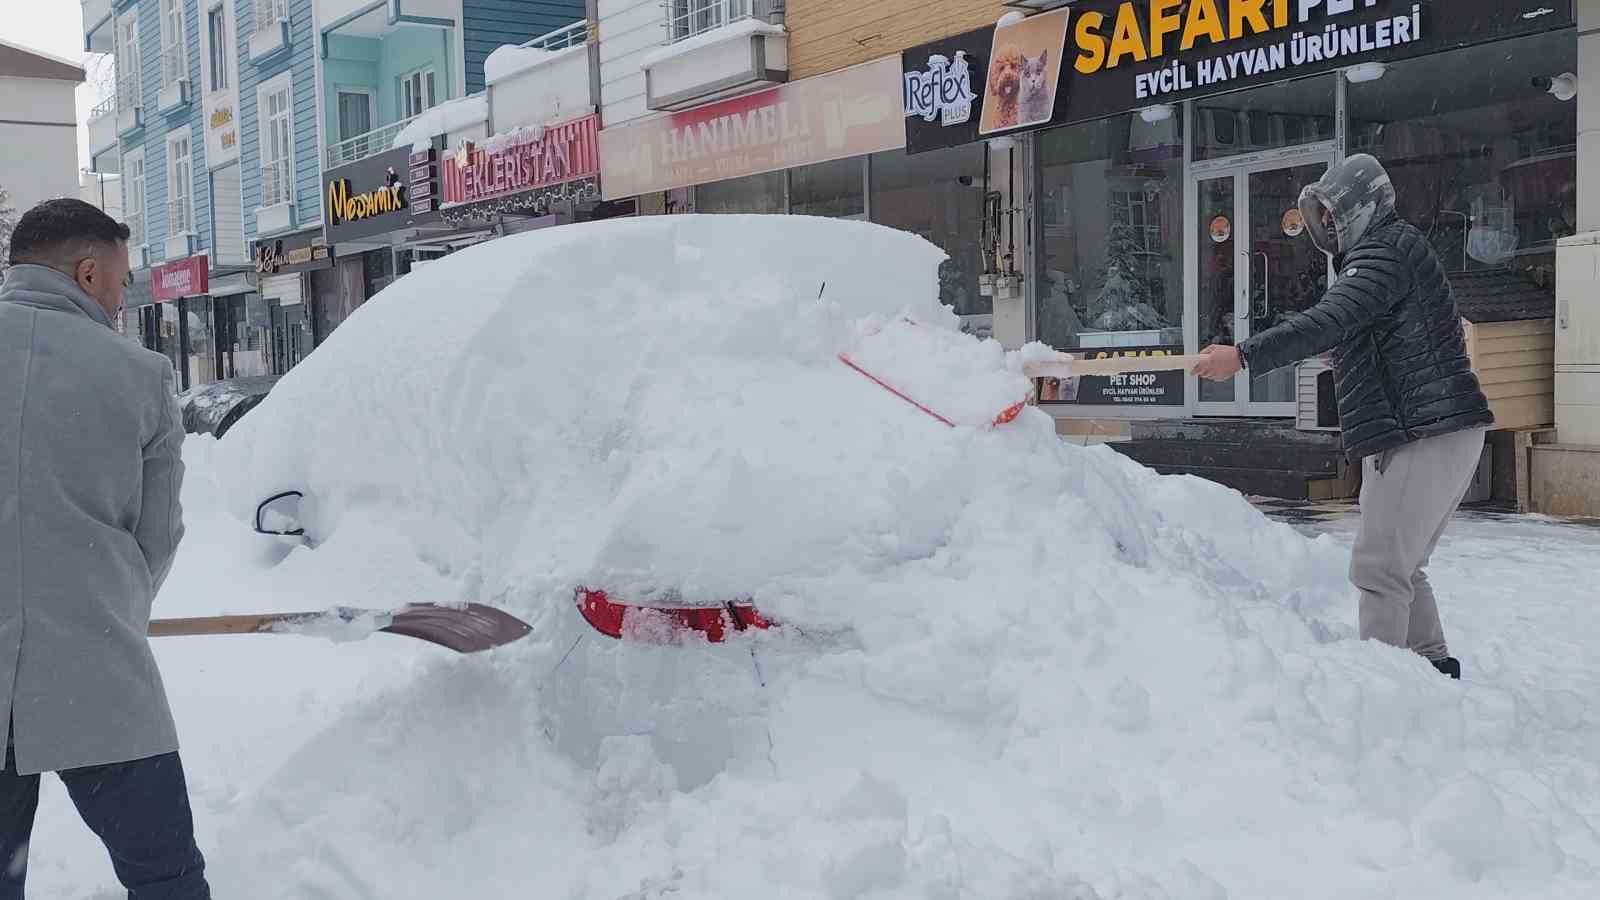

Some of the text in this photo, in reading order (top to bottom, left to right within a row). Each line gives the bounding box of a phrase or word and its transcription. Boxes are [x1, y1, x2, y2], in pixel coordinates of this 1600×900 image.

[1135, 59, 1193, 99] EVCİL
[1197, 42, 1285, 86] HAYVAN
[1291, 4, 1420, 66] ÜRÜNLERİ
[908, 66, 966, 116] Reflex
[944, 106, 968, 121] PLUS
[1110, 374, 1157, 386] PET SHOP
